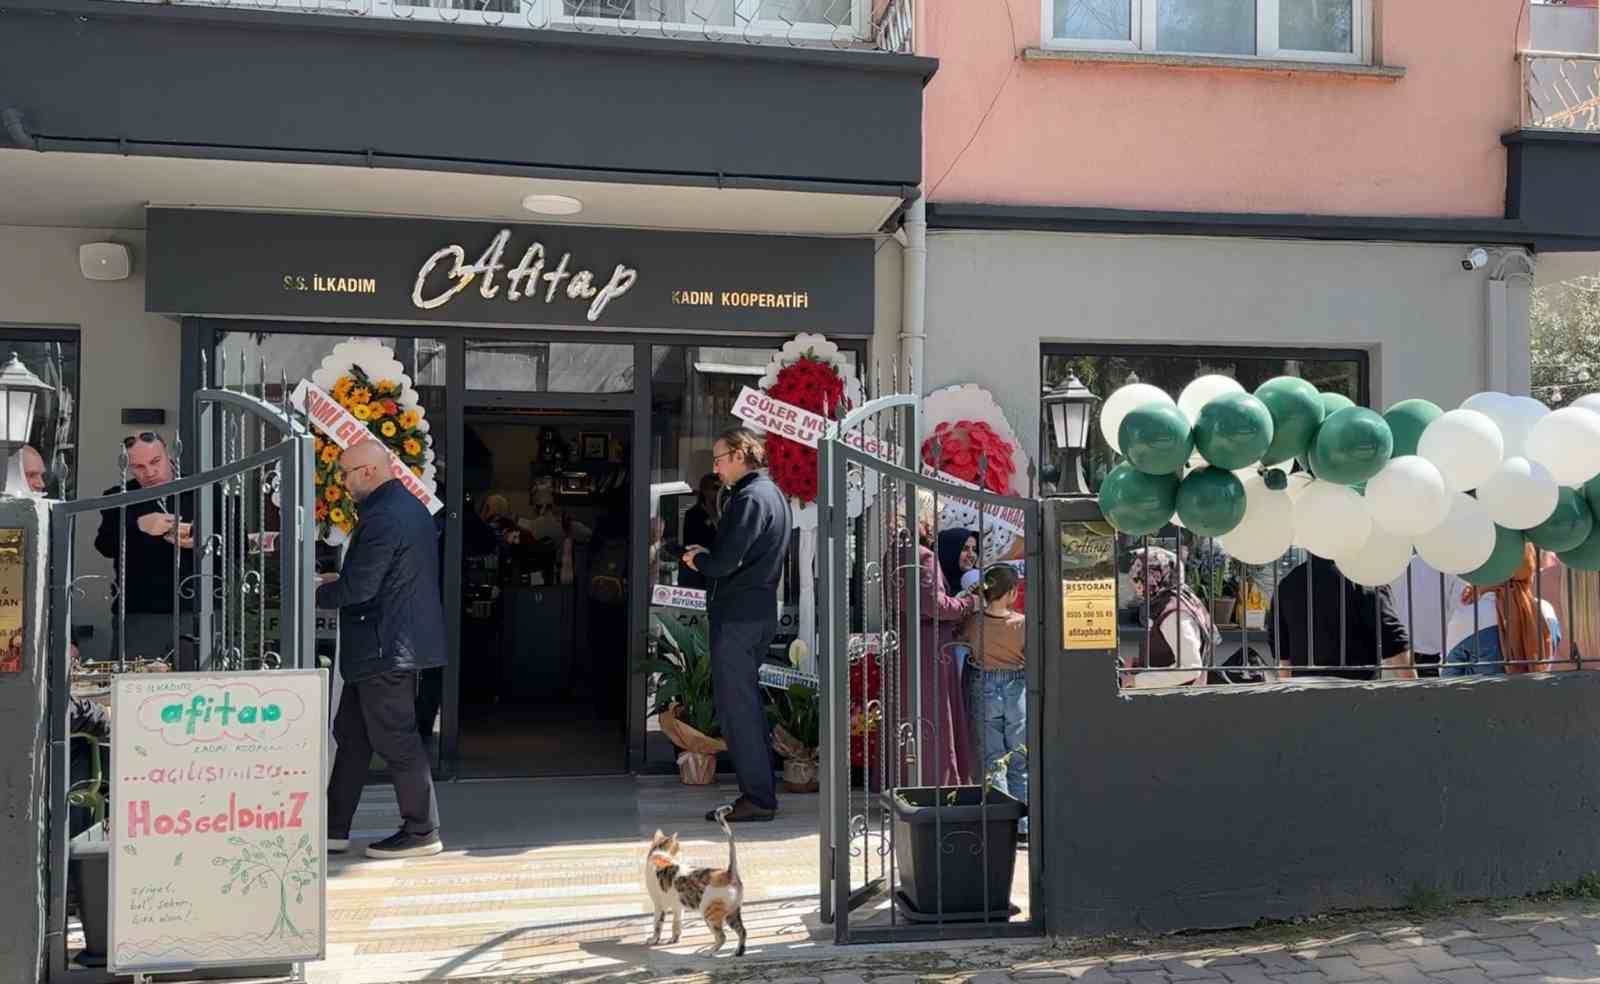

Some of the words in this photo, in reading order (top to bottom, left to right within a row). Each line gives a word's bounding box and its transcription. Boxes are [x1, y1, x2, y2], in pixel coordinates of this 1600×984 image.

[313, 273, 376, 293] İLKADIM
[412, 228, 637, 321] Afitap
[671, 291, 713, 305] KADIN
[721, 291, 809, 309] KOOPERATİFİ
[745, 394, 797, 423] GÜLER
[739, 406, 814, 442] CANSU
[1066, 583, 1112, 592] RESTORAN
